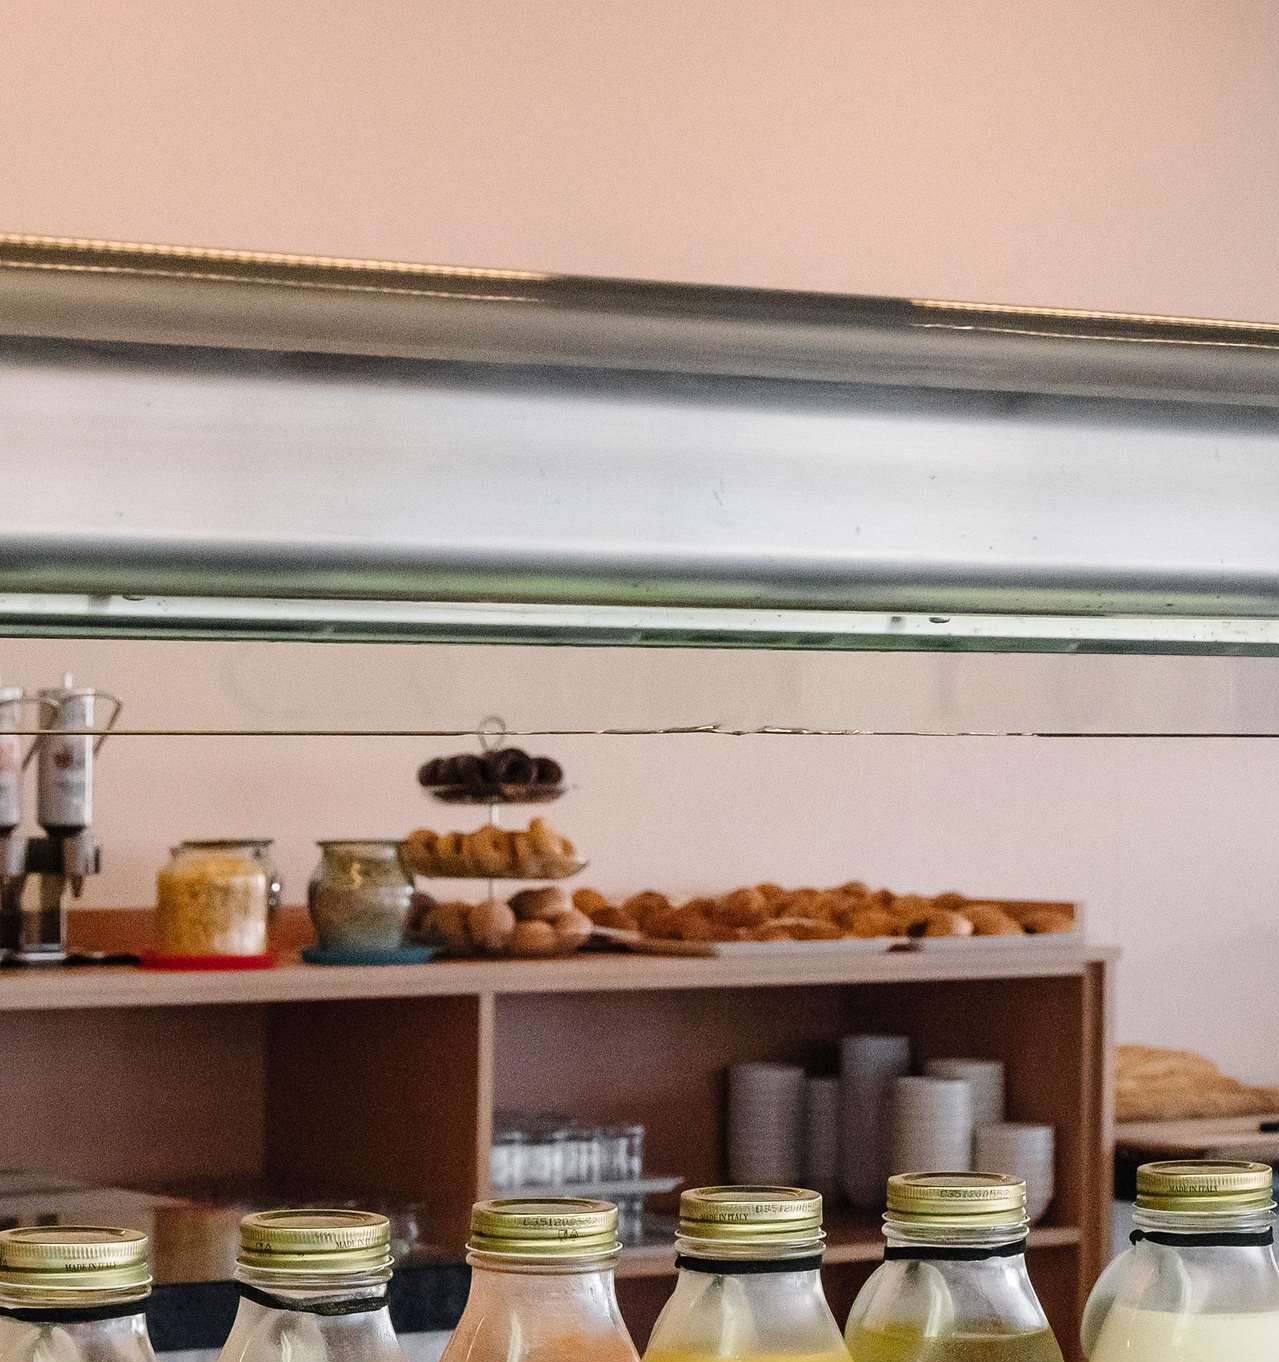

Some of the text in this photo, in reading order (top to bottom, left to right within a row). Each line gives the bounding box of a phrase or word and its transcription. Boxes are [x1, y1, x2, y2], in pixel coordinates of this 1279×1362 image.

[1169, 1184, 1218, 1193] MADE IN ITALY
[719, 1213, 727, 1221] IN
[727, 1213, 748, 1221] ITALY
[335, 1240, 355, 1249] MADE
[65, 1263, 88, 1273] MADE
[88, 1262, 97, 1271] IN
